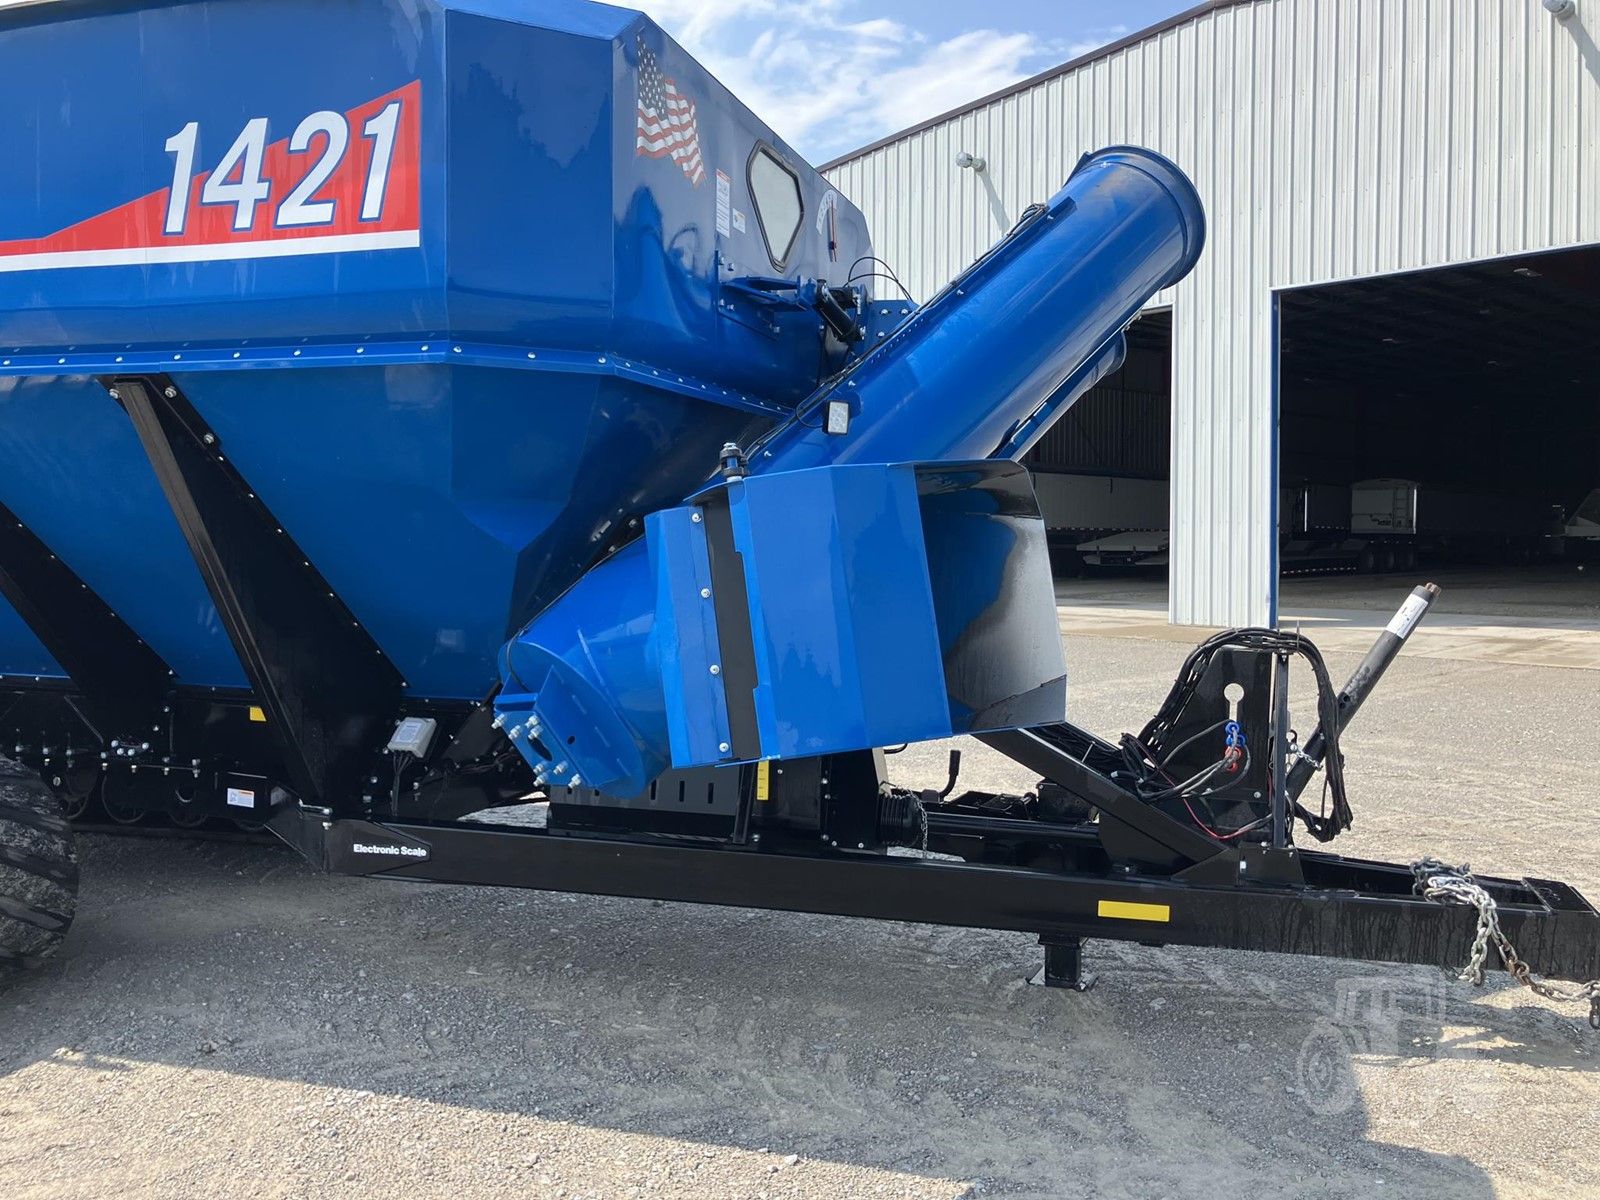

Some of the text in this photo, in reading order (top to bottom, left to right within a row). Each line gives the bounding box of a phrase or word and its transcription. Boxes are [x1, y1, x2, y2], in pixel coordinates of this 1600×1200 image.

[164, 102, 400, 233] 1421
[353, 844, 427, 857] Electronic Scale
